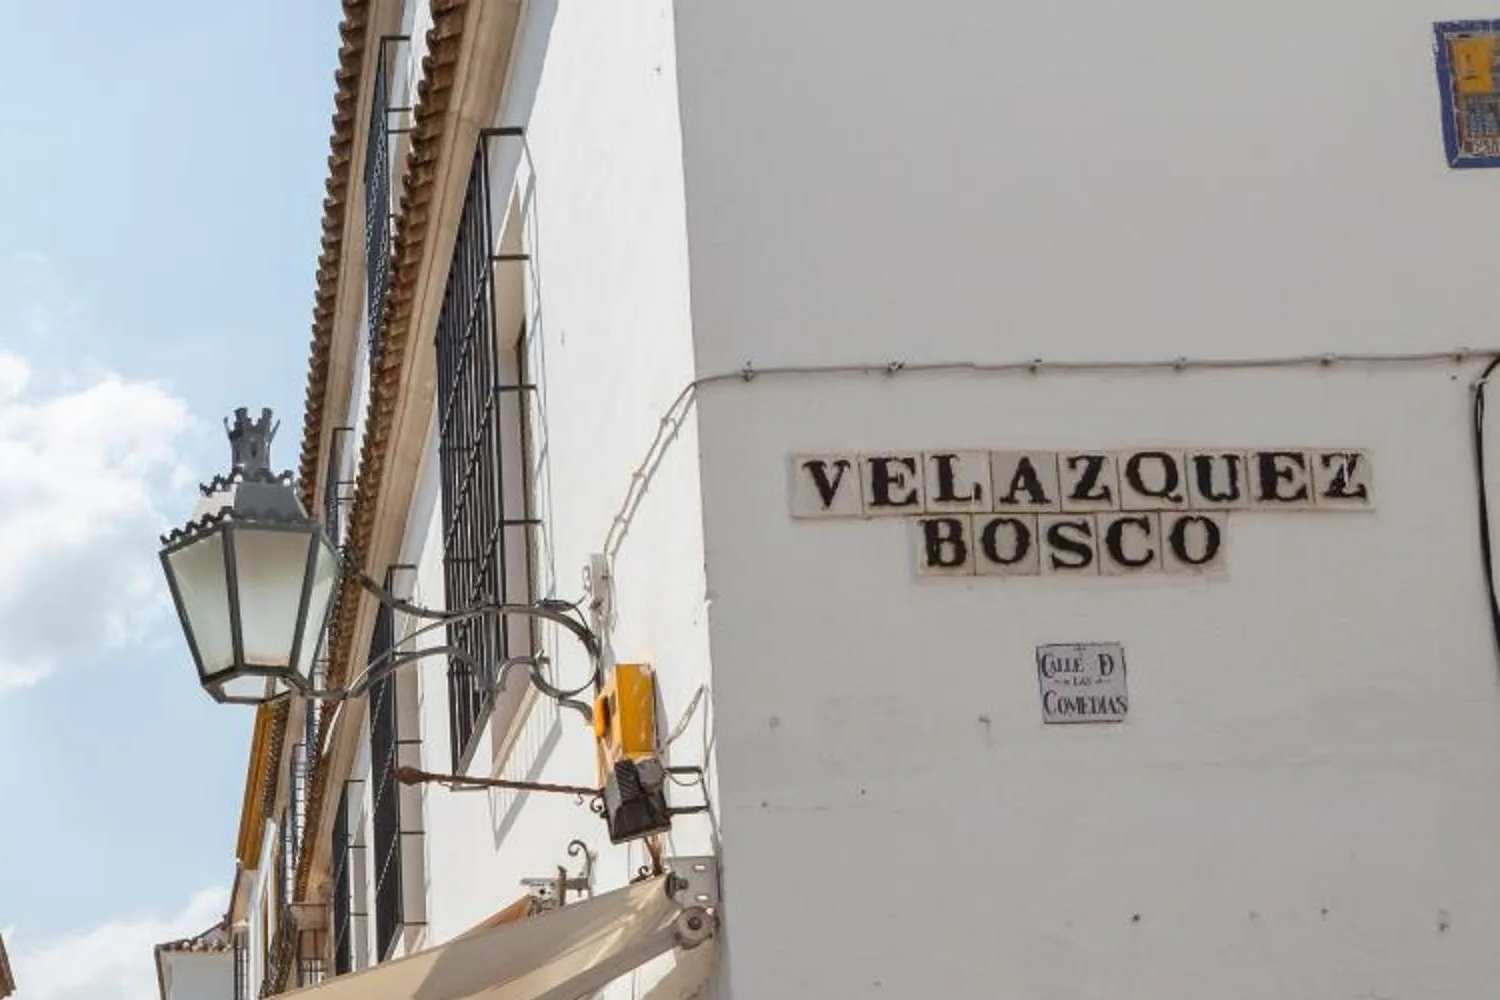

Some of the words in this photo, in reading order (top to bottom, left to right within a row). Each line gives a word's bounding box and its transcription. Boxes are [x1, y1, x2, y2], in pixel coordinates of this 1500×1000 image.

[802, 451, 1367, 510] VELAZQUEZ
[922, 514, 1222, 569] BOSCO
[1043, 689, 1128, 716] COMEDIAS
